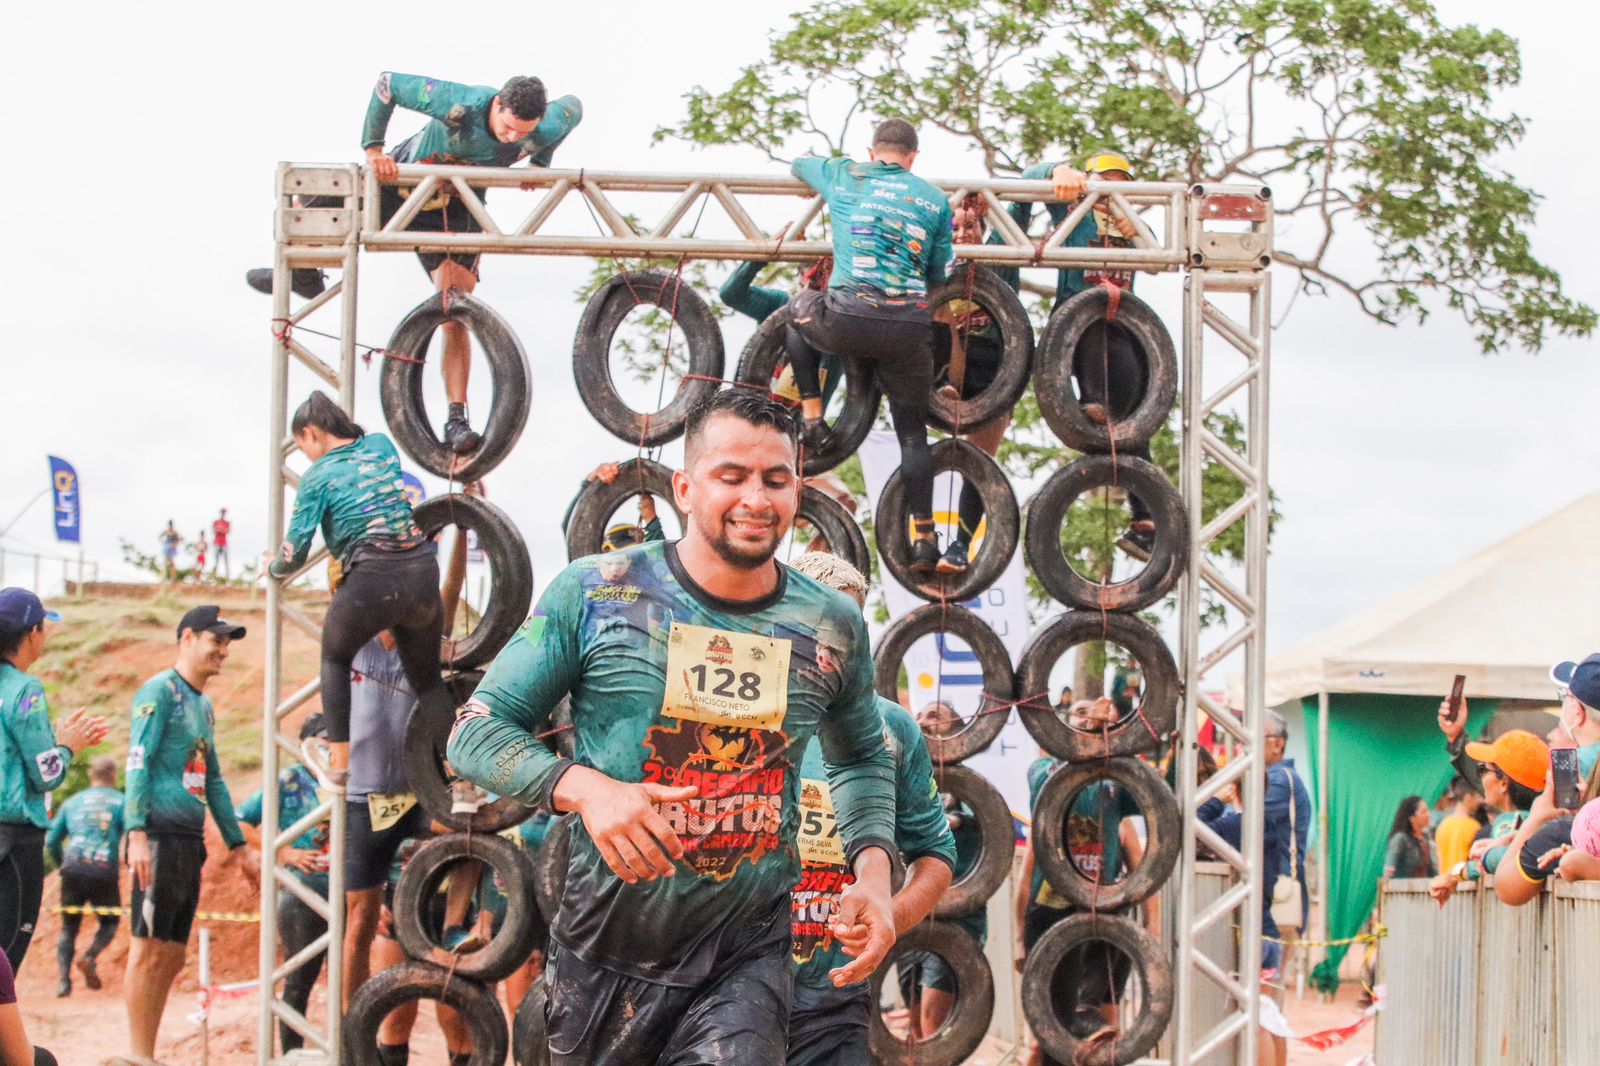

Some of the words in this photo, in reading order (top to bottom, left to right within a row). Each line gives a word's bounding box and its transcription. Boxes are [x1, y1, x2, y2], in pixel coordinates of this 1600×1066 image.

[914, 197, 941, 214] GCM
[690, 663, 761, 702] 128
[684, 692, 728, 709] FRANCISCO
[729, 703, 751, 712] NETO
[496, 737, 529, 768] NOV
[499, 749, 528, 786] 2022
[684, 767, 785, 798] DESAFIO
[653, 794, 782, 835] RUTUS
[798, 811, 839, 838] 57
[798, 837, 815, 846] ERME
[695, 856, 727, 868] 2022
[794, 871, 857, 893] SAFIO
